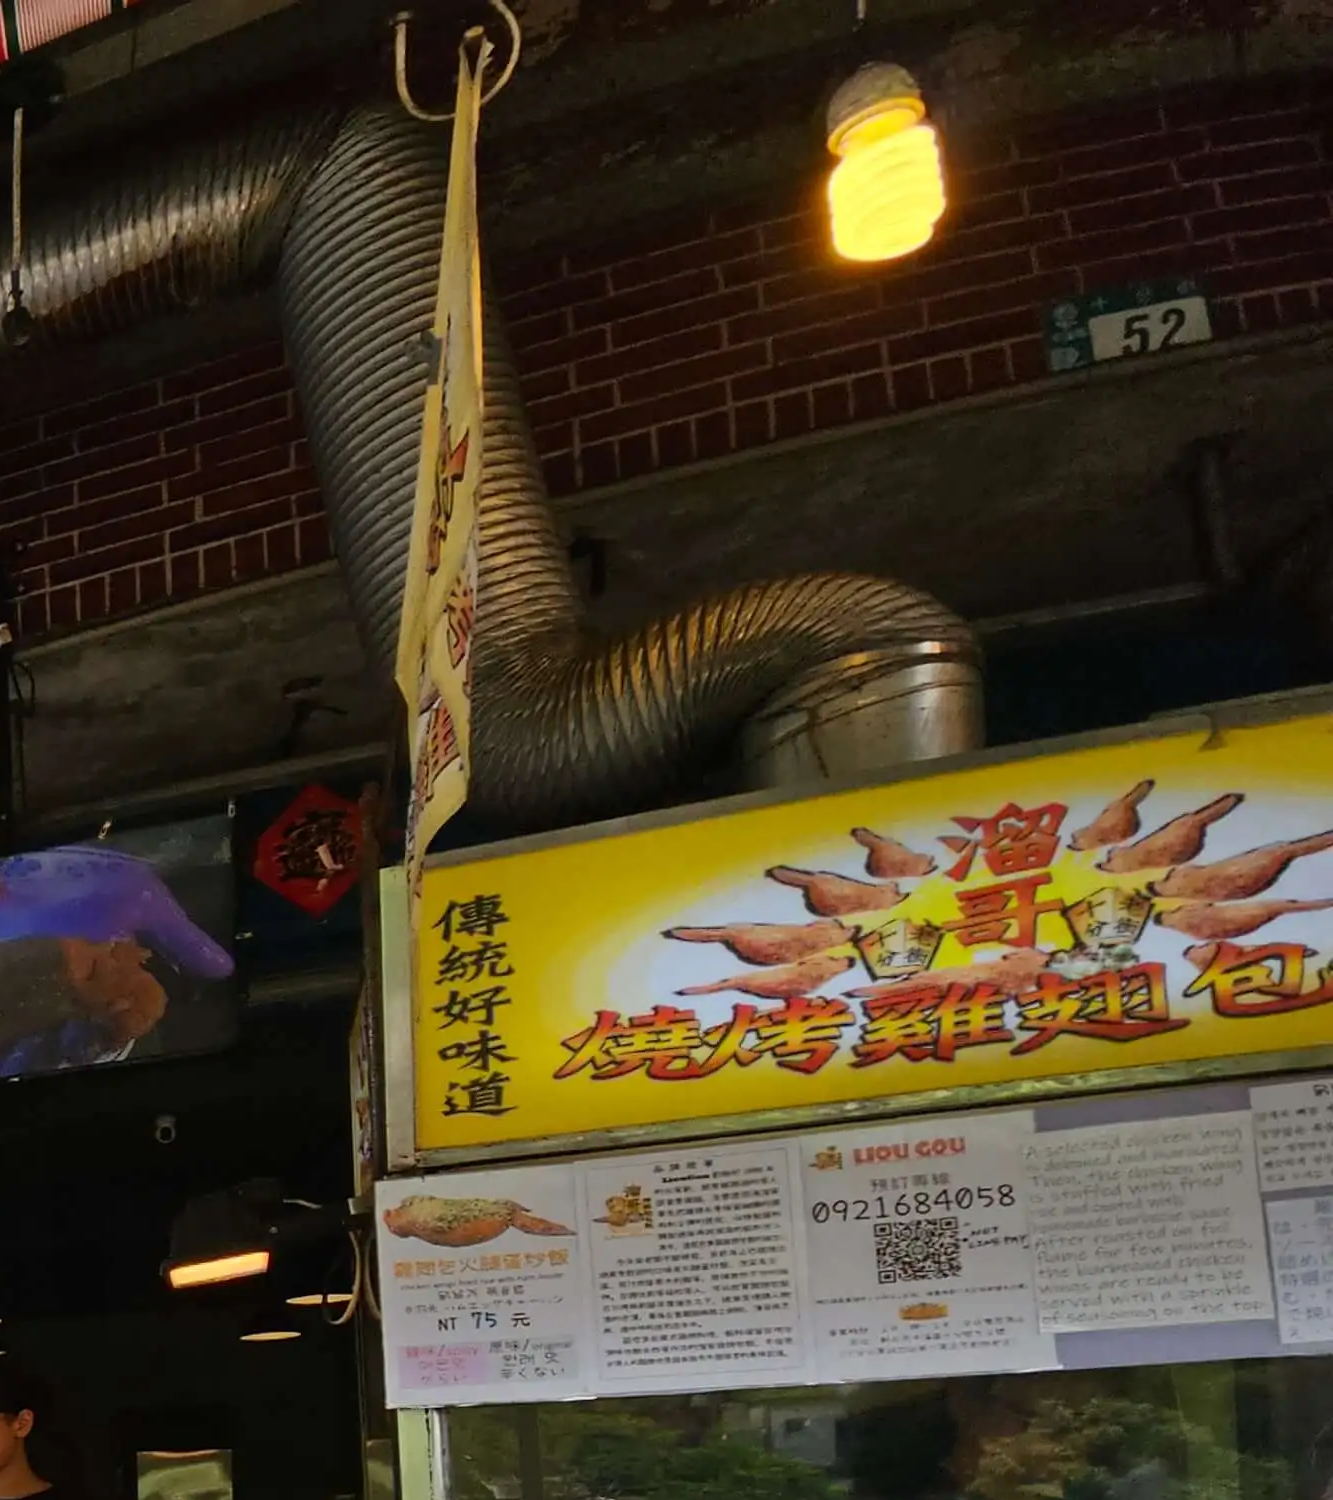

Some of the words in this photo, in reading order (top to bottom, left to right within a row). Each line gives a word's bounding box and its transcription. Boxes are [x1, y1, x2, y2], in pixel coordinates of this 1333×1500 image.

[1122, 307, 1186, 356] 52
[937, 801, 1069, 948] 溜哥
[431, 893, 520, 1118] 傳統好味道
[554, 941, 1333, 1083] 燒烤雞翅包
[852, 1142, 910, 1165] LIOU
[914, 1136, 967, 1159] GOU
[811, 1183, 1017, 1224] 0921684058
[437, 1316, 459, 1331] NT
[471, 1312, 498, 1328] 75
[511, 1312, 532, 1327] 元
